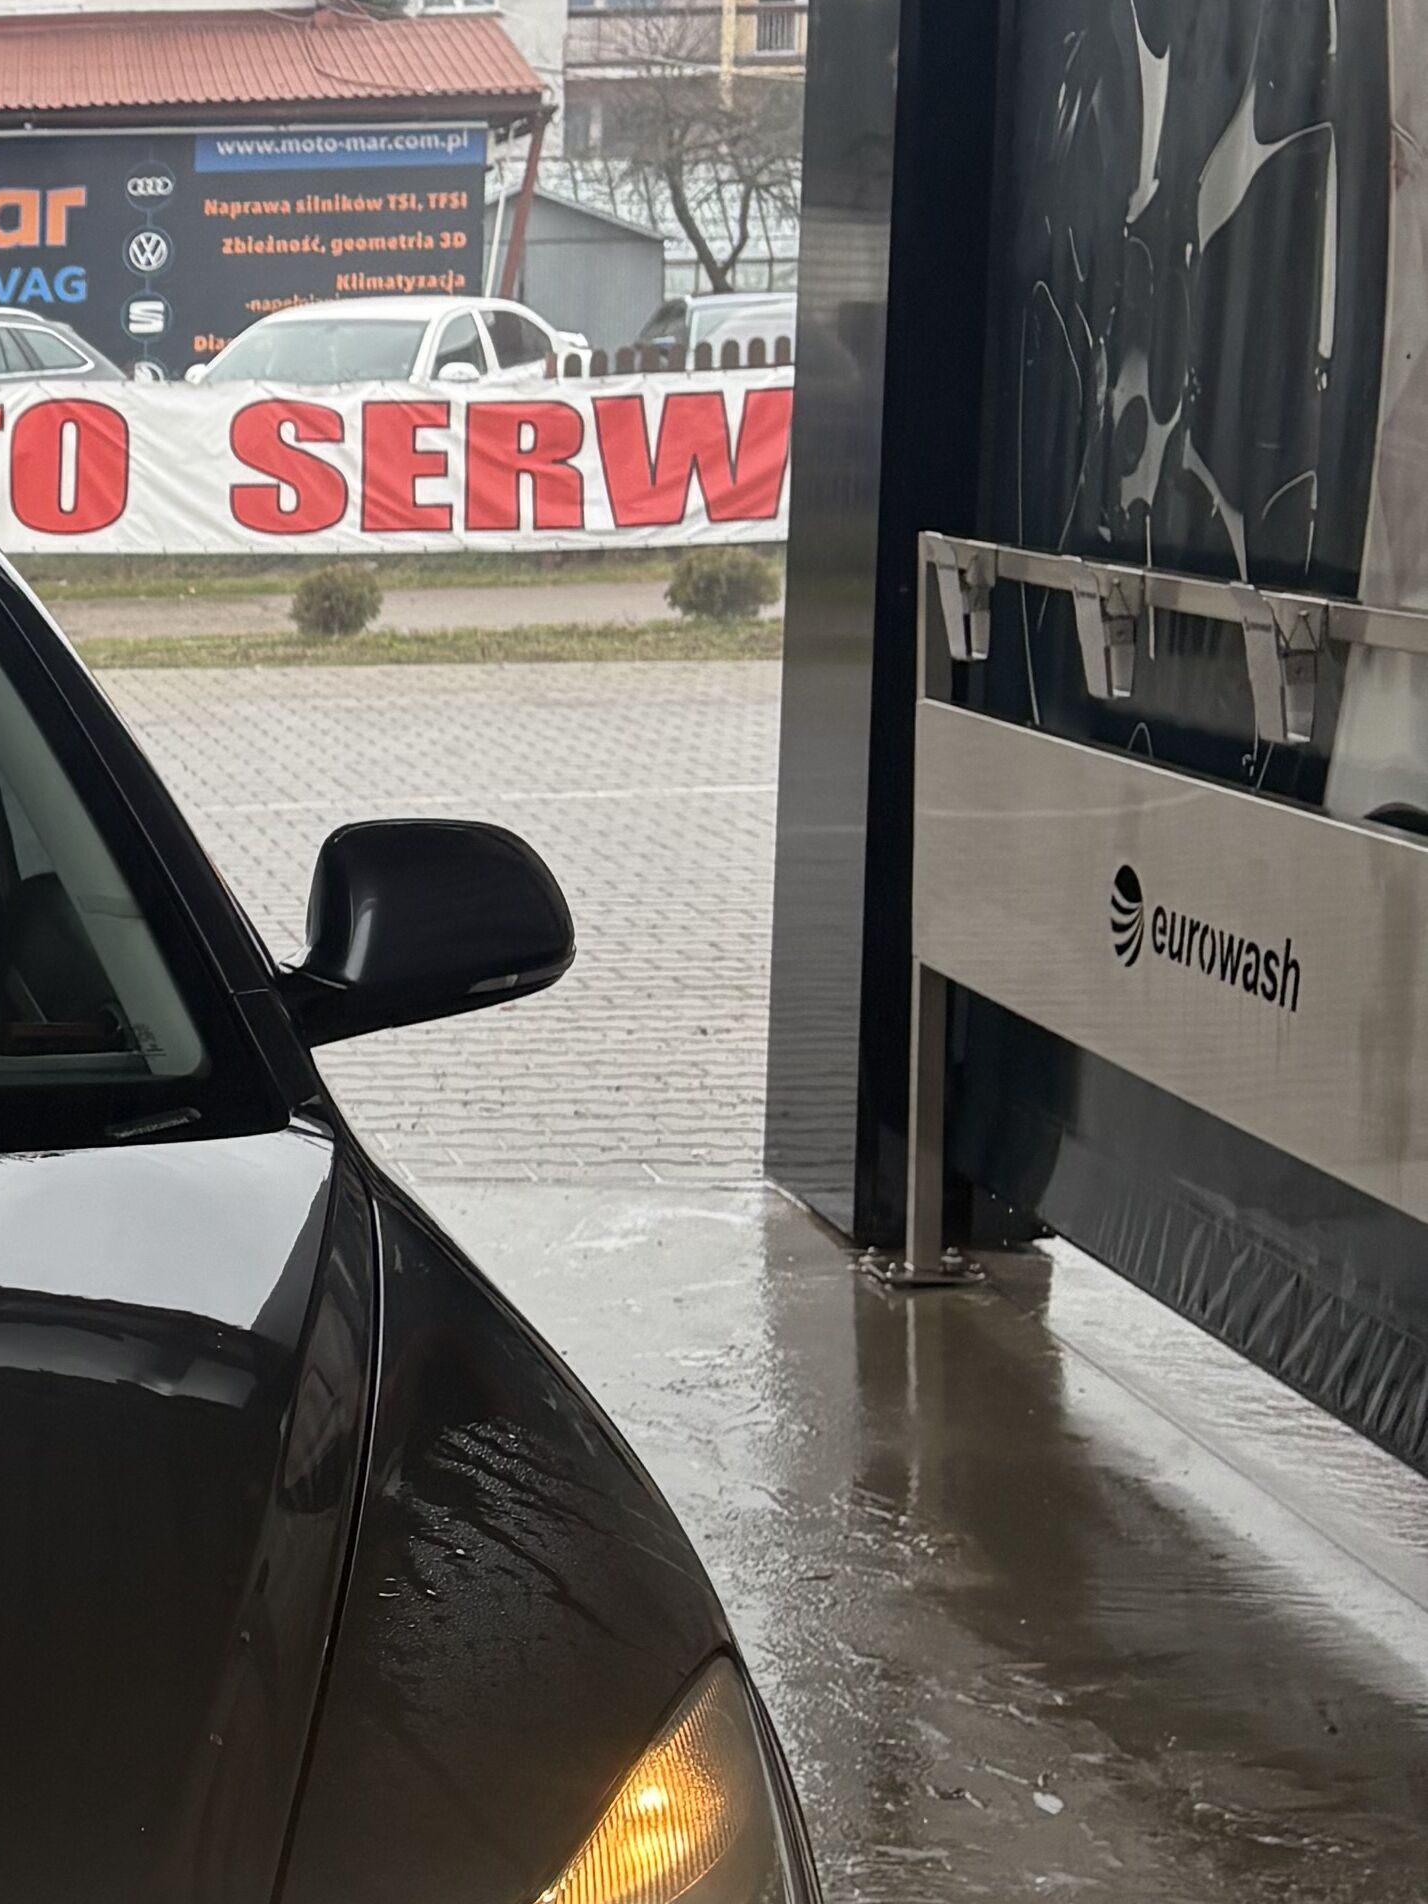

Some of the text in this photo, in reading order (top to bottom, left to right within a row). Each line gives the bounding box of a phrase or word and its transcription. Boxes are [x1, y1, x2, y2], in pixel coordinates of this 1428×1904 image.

[216, 130, 468, 156] www.moto-mar.com.pl
[204, 192, 468, 219] Naprawa silników TSI, TFSI
[222, 231, 467, 256] Zbieżność, geometria 3D
[336, 270, 466, 294] Klimatyzacja
[1152, 904, 1301, 1013] eurowash
